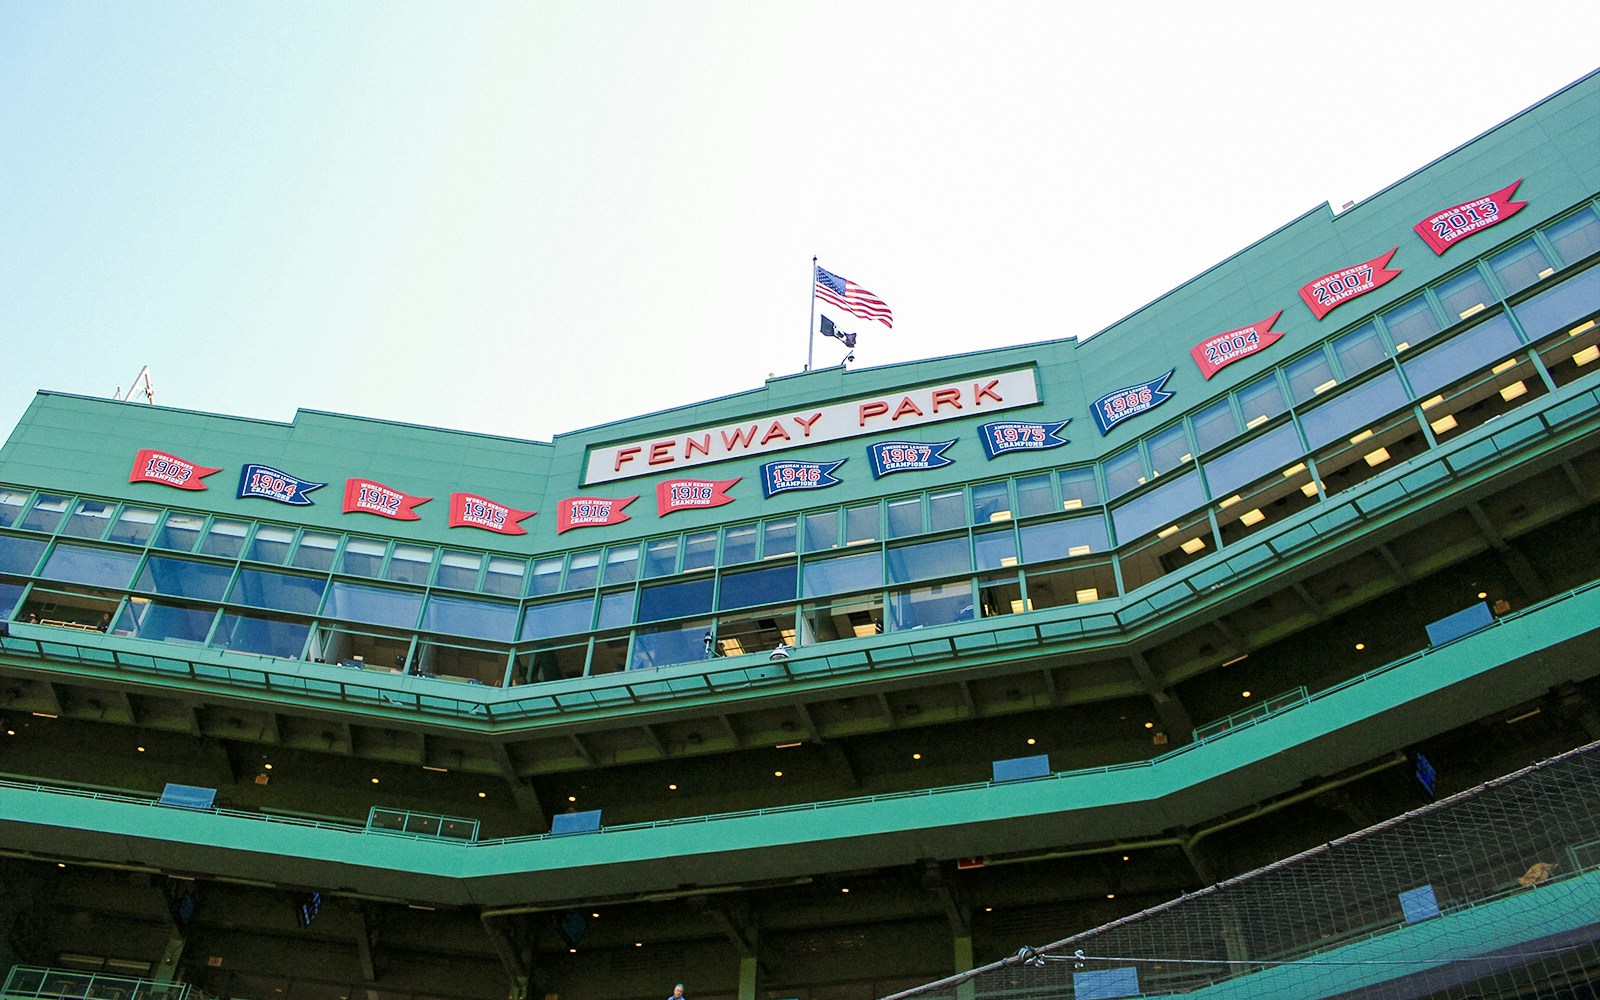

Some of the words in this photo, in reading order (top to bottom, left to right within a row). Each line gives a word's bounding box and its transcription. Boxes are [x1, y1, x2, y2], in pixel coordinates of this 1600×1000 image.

[1430, 208, 1459, 223] WORLD
[1460, 197, 1490, 212] SERIES
[1433, 202, 1499, 238] 2013
[1445, 215, 1499, 242] CHAMPIONS
[1313, 273, 1340, 288] WORLD
[1341, 264, 1368, 276] SERIES
[1313, 268, 1373, 304] 2007
[1324, 282, 1374, 306] CHAMPIONS
[1206, 334, 1230, 347] WORLD
[1230, 327, 1254, 338] SERIES
[1205, 332, 1260, 363] 2004
[1214, 344, 1258, 365] CHAMPIONS
[1104, 391, 1128, 404] AMERICAN
[1104, 389, 1152, 418] 1986
[1110, 402, 1150, 422] CHAMPIONS
[614, 412, 822, 472] FENWAY
[858, 379, 1003, 427] PARK
[994, 428, 1045, 444] 1975
[152, 454, 173, 463] WORLD
[175, 459, 193, 470] SERIES
[882, 449, 931, 464] 1967
[145, 471, 184, 485] CHAMPIONS
[146, 458, 191, 481] 1903
[256, 469, 279, 478] AMERICAN
[774, 468, 821, 483] 1946
[250, 487, 290, 501] CHAMPIONS
[251, 473, 297, 496] 1904
[361, 483, 381, 491] WORLD
[383, 488, 403, 500] SERIES
[671, 487, 712, 500] 1918
[357, 501, 396, 515] CHAMPIONS
[360, 488, 400, 511] 1912
[466, 497, 487, 506] WORLD
[488, 502, 508, 513] SERIES
[464, 502, 507, 524] 1915
[571, 505, 610, 518] 1916
[463, 515, 503, 530] CHAMPIONS
